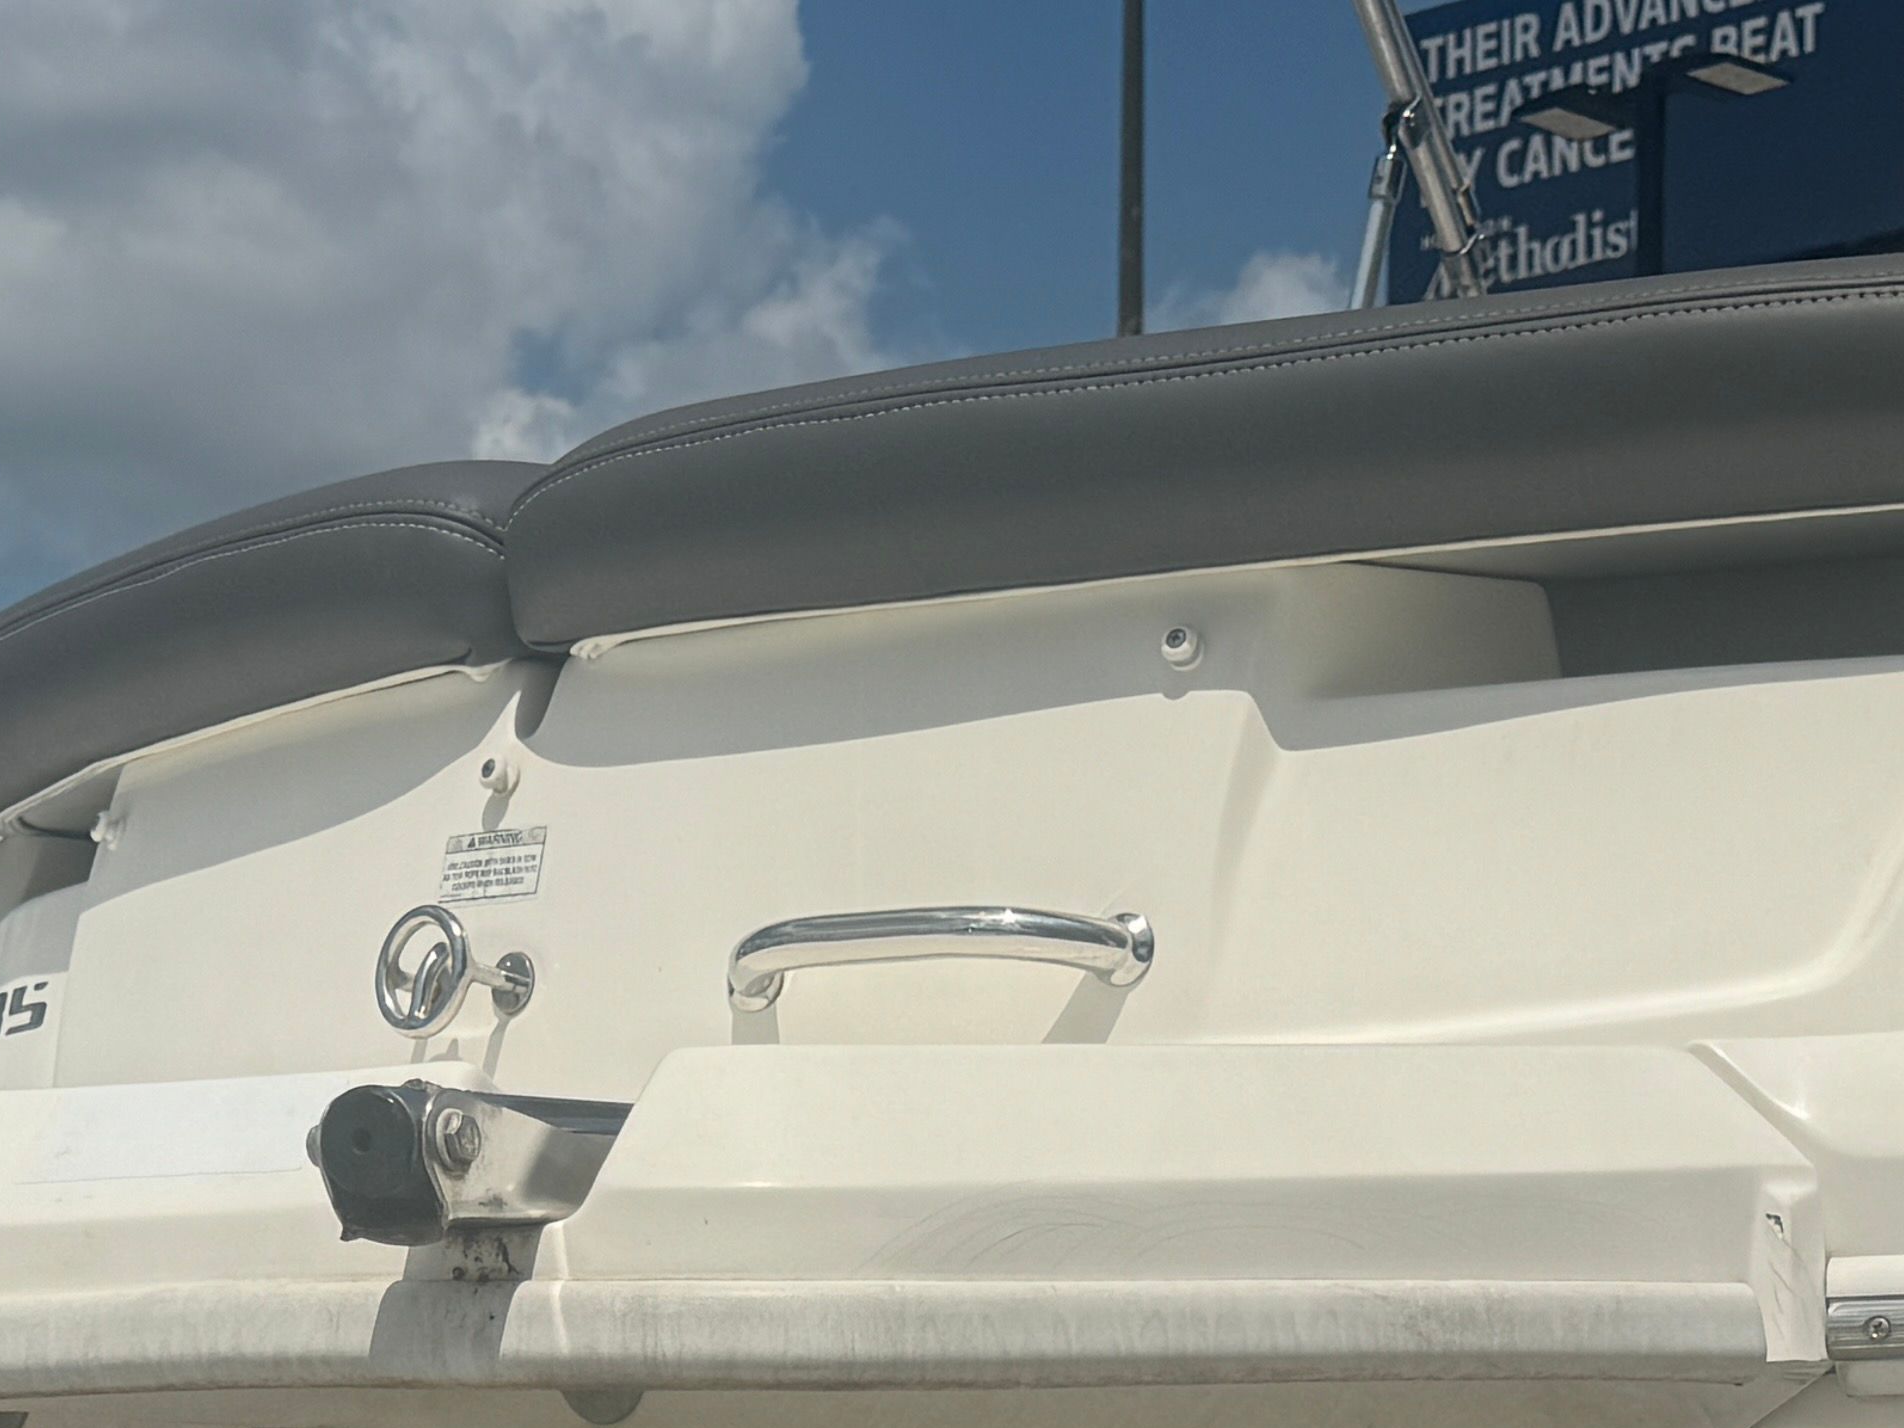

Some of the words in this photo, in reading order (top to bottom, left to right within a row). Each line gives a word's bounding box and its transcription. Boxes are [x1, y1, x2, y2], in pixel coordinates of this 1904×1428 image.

[1421, 12, 1542, 83] THEIR
[1710, 3, 1825, 63] BEAT
[1497, 128, 1637, 188] CANCE
